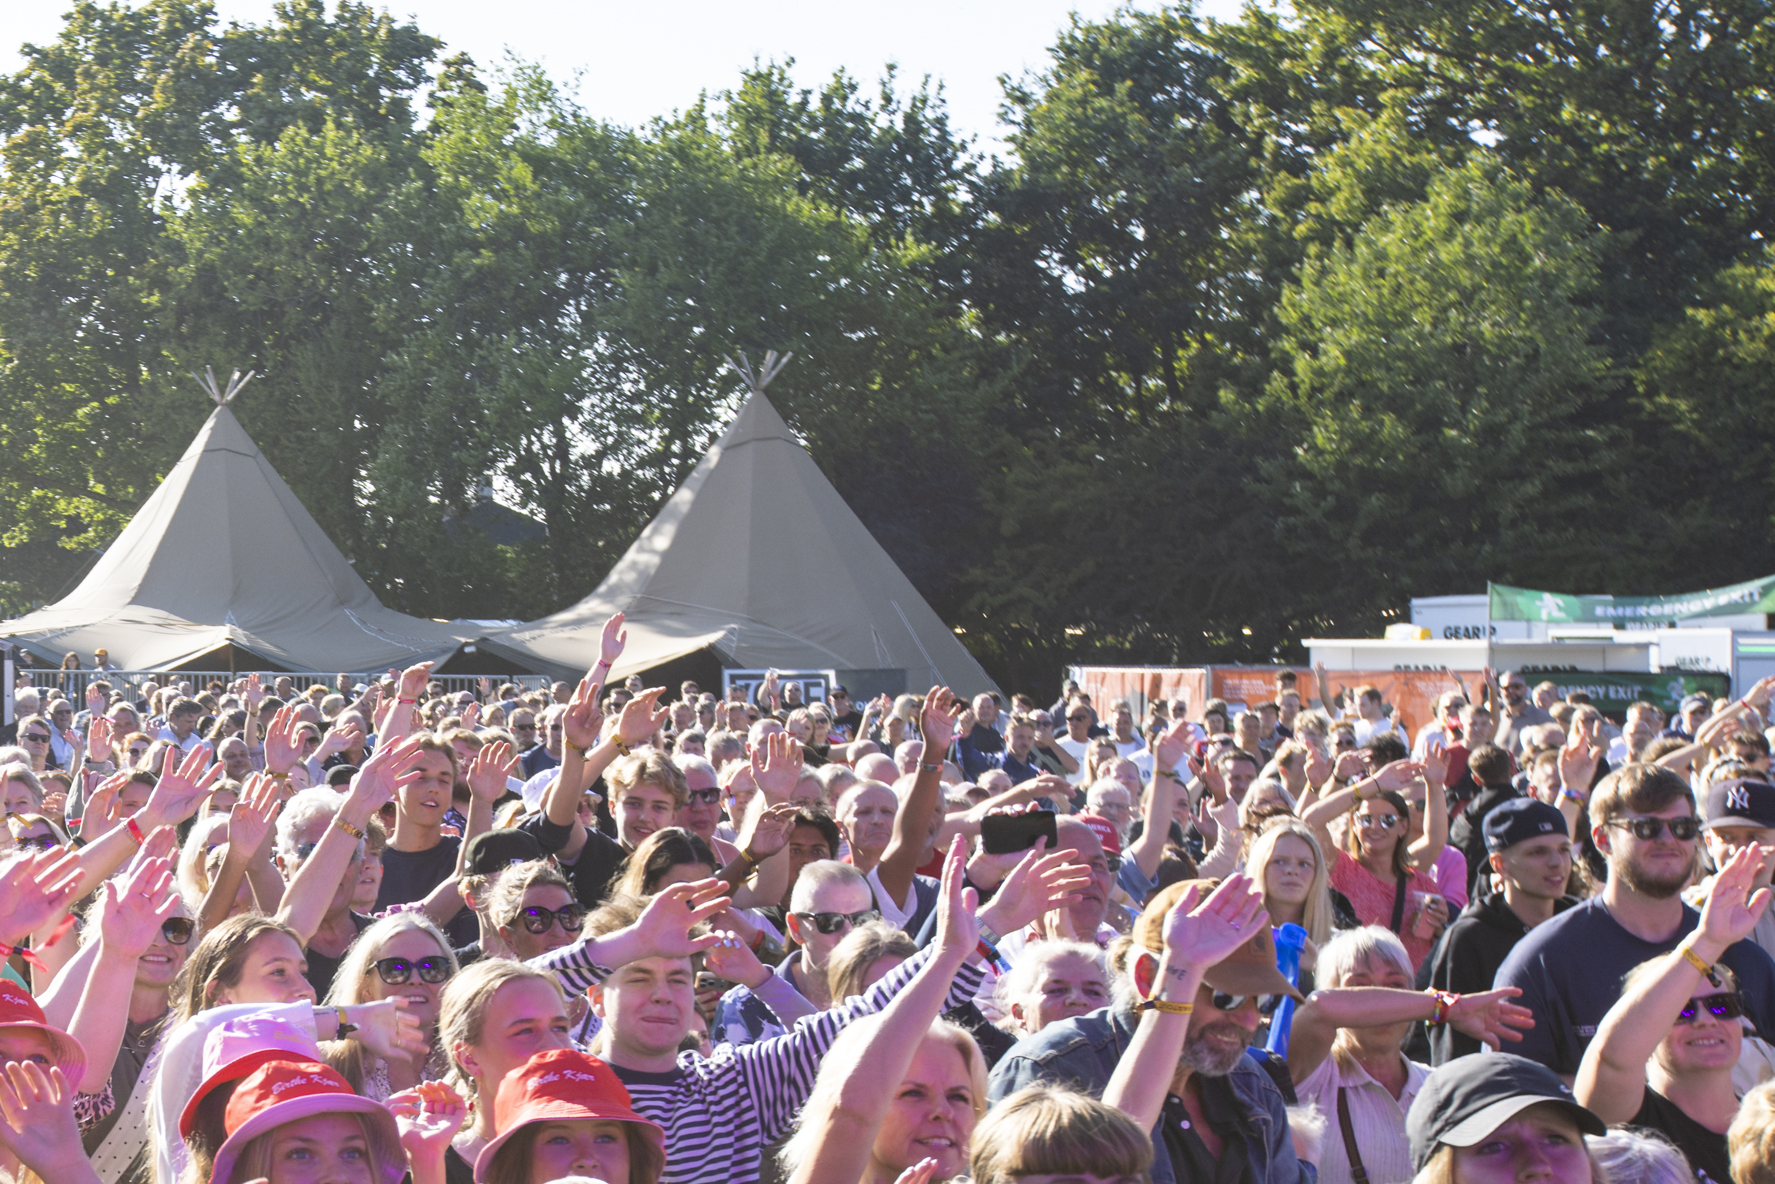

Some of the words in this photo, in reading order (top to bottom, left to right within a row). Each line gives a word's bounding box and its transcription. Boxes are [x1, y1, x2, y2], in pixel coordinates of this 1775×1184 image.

[1594, 597, 1715, 617] EMERGENCY
[1716, 586, 1763, 605] EXIT
[1608, 685, 1643, 700] EXIT
